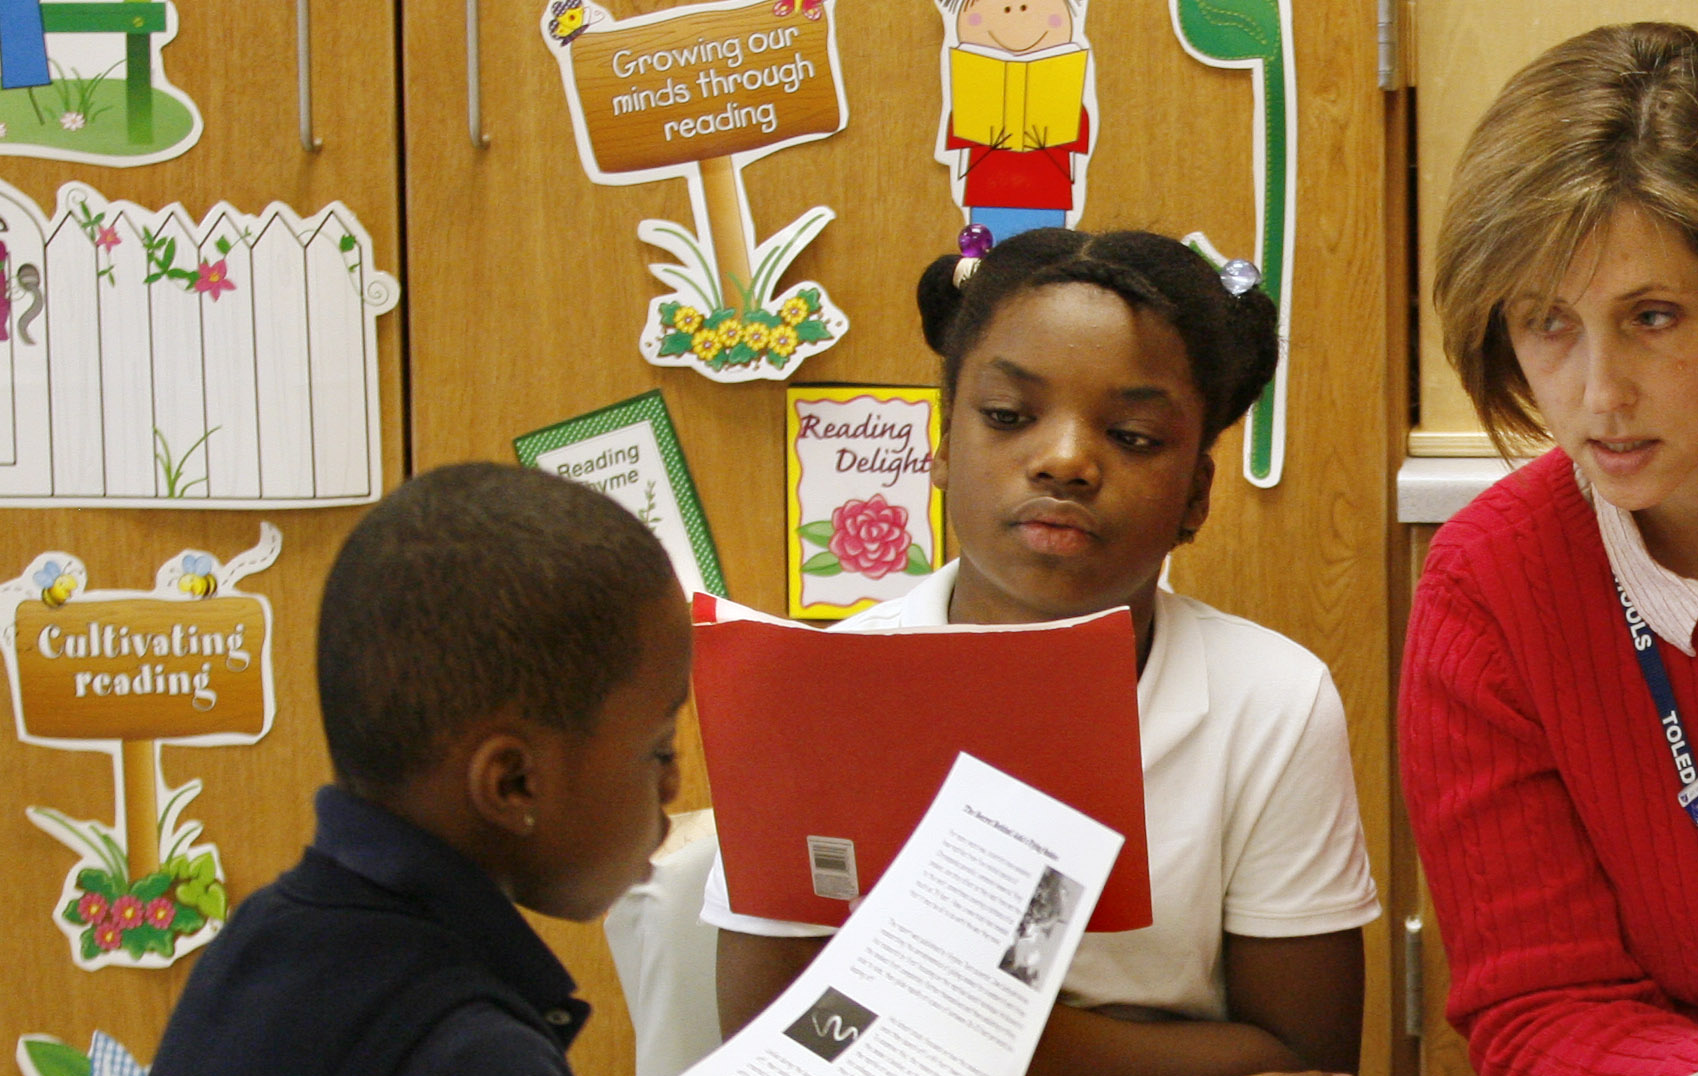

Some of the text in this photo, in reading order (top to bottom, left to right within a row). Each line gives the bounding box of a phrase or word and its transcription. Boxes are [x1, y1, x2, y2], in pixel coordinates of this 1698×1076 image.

[612, 26, 799, 78] Growing our
[612, 52, 815, 116] minds through
[664, 102, 777, 141] reading
[799, 412, 912, 454] Reading
[557, 444, 640, 479] Reading
[835, 447, 933, 488] Delight
[37, 621, 251, 673] Cultivating
[74, 661, 217, 712] reading
[1662, 709, 1697, 785] TOLED
